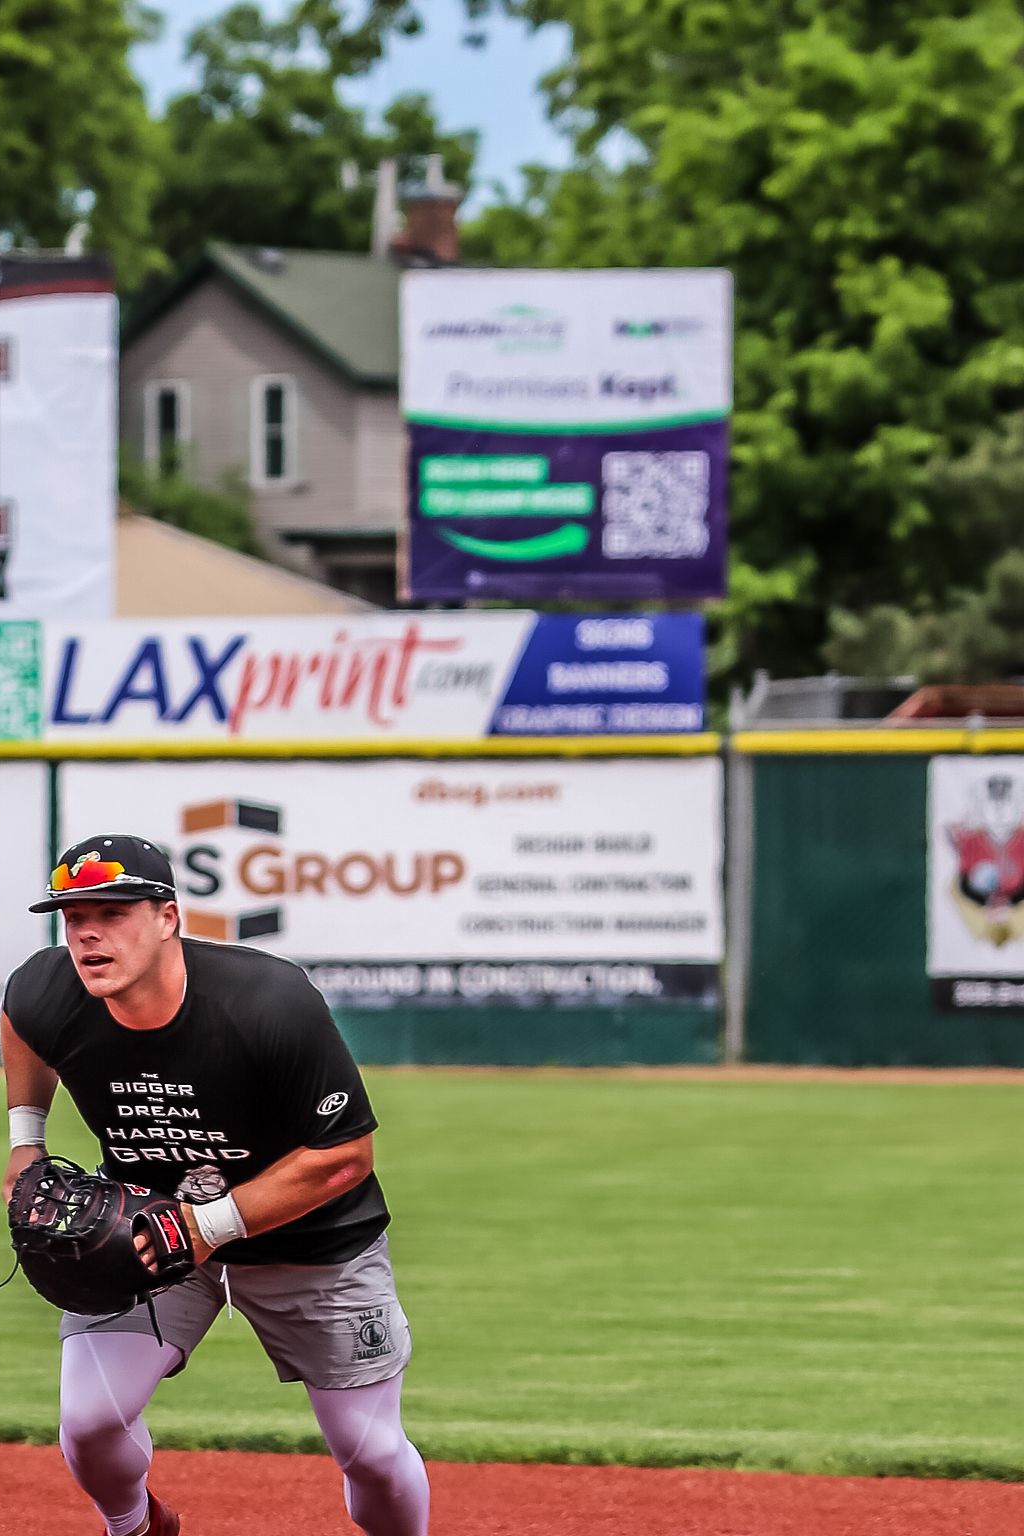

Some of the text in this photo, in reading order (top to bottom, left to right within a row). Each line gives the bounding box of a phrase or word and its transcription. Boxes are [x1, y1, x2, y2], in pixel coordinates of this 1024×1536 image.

[547, 661, 669, 693] BANNERS
[237, 845, 465, 897] GROUP
[425, 965, 453, 994] IN
[110, 1082, 195, 1096] BIGGER
[117, 1105, 201, 1119] DREAM
[106, 1127, 229, 1142] HARDER
[109, 1146, 251, 1163] GRIND
